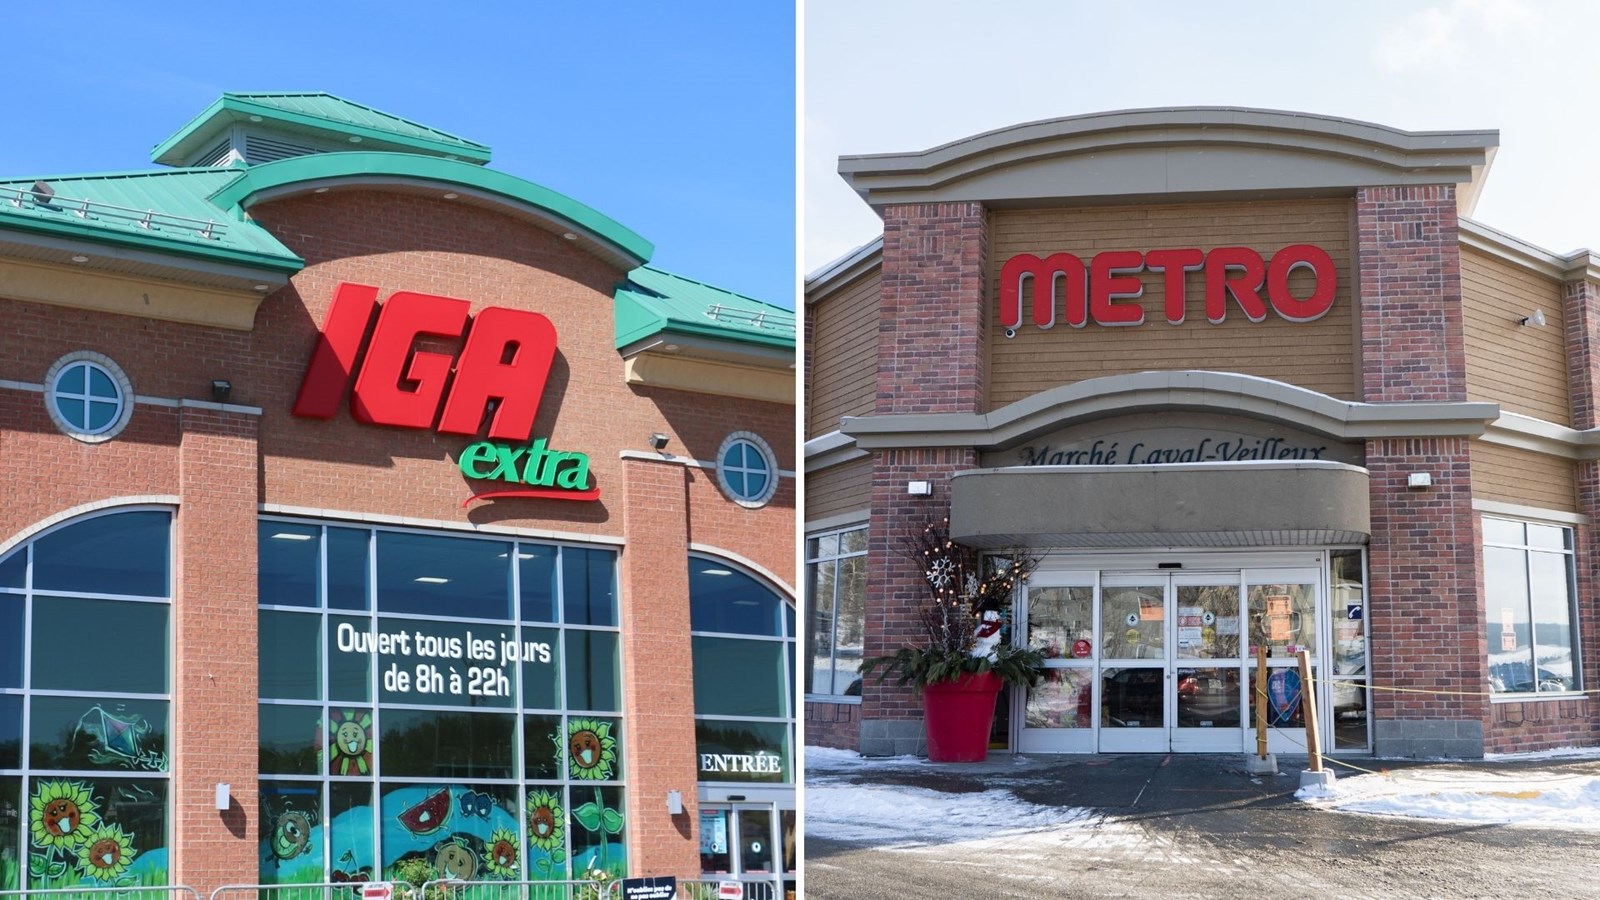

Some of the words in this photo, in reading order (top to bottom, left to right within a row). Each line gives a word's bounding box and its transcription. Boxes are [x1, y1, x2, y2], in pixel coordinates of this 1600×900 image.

[999, 244, 1338, 329] METRO
[291, 281, 558, 440] IGA
[458, 437, 591, 490] extra
[1019, 440, 1118, 466] Marché
[1127, 438, 1326, 465] Laval-Veilleux
[337, 623, 411, 655] Ouvert
[415, 631, 462, 658] tous
[466, 631, 496, 660] les
[500, 633, 551, 667] jours
[384, 663, 410, 692] de
[416, 664, 444, 693] 8h
[449, 667, 462, 694] à
[468, 667, 510, 696] 22h
[700, 751, 781, 773] ENTRÉE
